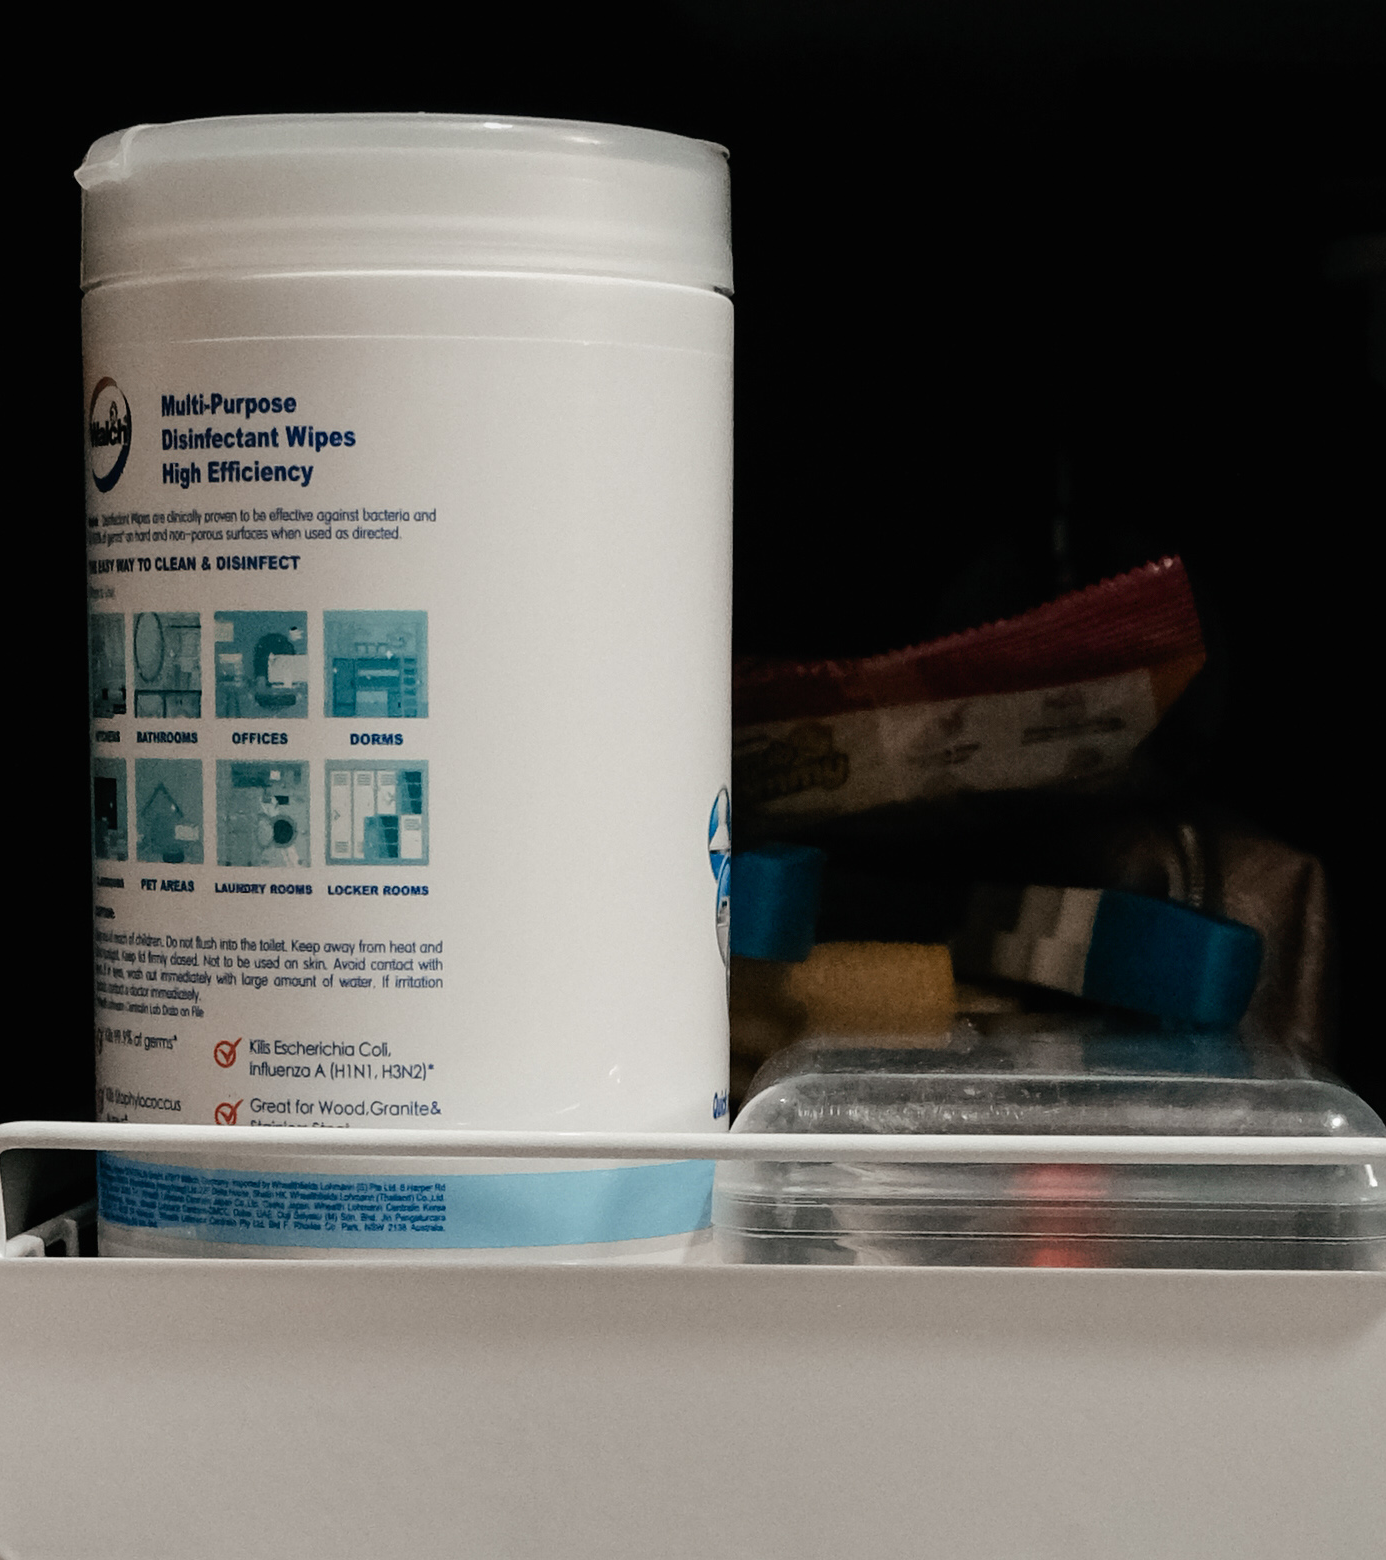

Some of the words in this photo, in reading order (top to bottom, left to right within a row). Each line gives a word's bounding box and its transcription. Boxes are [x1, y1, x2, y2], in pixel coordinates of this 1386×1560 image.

[162, 392, 297, 419] Multi-Purpose
[162, 427, 279, 451] Disinfectant
[285, 425, 357, 452] Wipes
[162, 462, 201, 489] High
[208, 460, 314, 487] Efficiency
[167, 509, 202, 525] clinically
[204, 512, 238, 525] proven
[240, 510, 250, 522] to
[253, 508, 266, 522] be
[269, 508, 313, 522] effective
[316, 508, 359, 525] against
[363, 508, 410, 522] bacteria
[413, 508, 437, 522] and
[169, 529, 223, 543] non-porous
[226, 526, 268, 540] surfaces
[271, 526, 301, 540] when
[304, 526, 332, 540] used
[335, 528, 349, 540] as
[352, 526, 403, 540] directed.
[116, 558, 135, 572] WAY
[137, 557, 151, 571] TO
[155, 556, 196, 571] CLEAN
[201, 556, 211, 571] &
[216, 555, 301, 570] DISINFECT
[136, 731, 199, 744] BATHROOMS
[231, 732, 288, 745] OFFICES
[350, 733, 404, 746] DORMS
[140, 878, 158, 892] PET
[160, 879, 195, 893] AREAS
[215, 882, 266, 895] LAUNDRY
[270, 884, 313, 896] ROOMS
[327, 885, 379, 896] LOCKER
[382, 885, 429, 896] ROOMS
[166, 935, 178, 948] Do
[179, 936, 194, 948] not
[196, 936, 217, 950] flush
[220, 937, 238, 950] into
[240, 937, 257, 951] the
[259, 938, 287, 952] toilet.
[291, 939, 320, 955] Keep
[324, 942, 355, 956] away
[359, 940, 386, 953] from
[389, 940, 416, 953] heat
[419, 940, 443, 953] and
[170, 951, 199, 966] closed.
[203, 953, 221, 967] Not
[223, 955, 233, 967] to
[237, 955, 250, 968] be
[254, 956, 280, 970] used
[284, 958, 298, 970] on
[303, 958, 328, 971] skin.
[333, 957, 366, 971] Avoid
[370, 958, 414, 971] contact
[417, 958, 443, 971] with
[146, 970, 157, 981] out
[160, 971, 212, 986] immediately
[216, 972, 237, 986] with
[241, 972, 269, 989] large
[273, 975, 317, 988] amount
[322, 974, 335, 988] of
[382, 975, 390, 988] If
[394, 975, 443, 988] irritation
[180, 1006, 190, 1017] on
[191, 1005, 204, 1017] File
[249, 1039, 271, 1055] Kills
[274, 1040, 355, 1057] Escherichia
[359, 1041, 392, 1058] Coli,
[249, 1061, 311, 1079] Influenza
[314, 1063, 326, 1079] A
[330, 1062, 378, 1080] (H1N1,
[250, 1097, 291, 1114] Great
[295, 1099, 314, 1115] for
